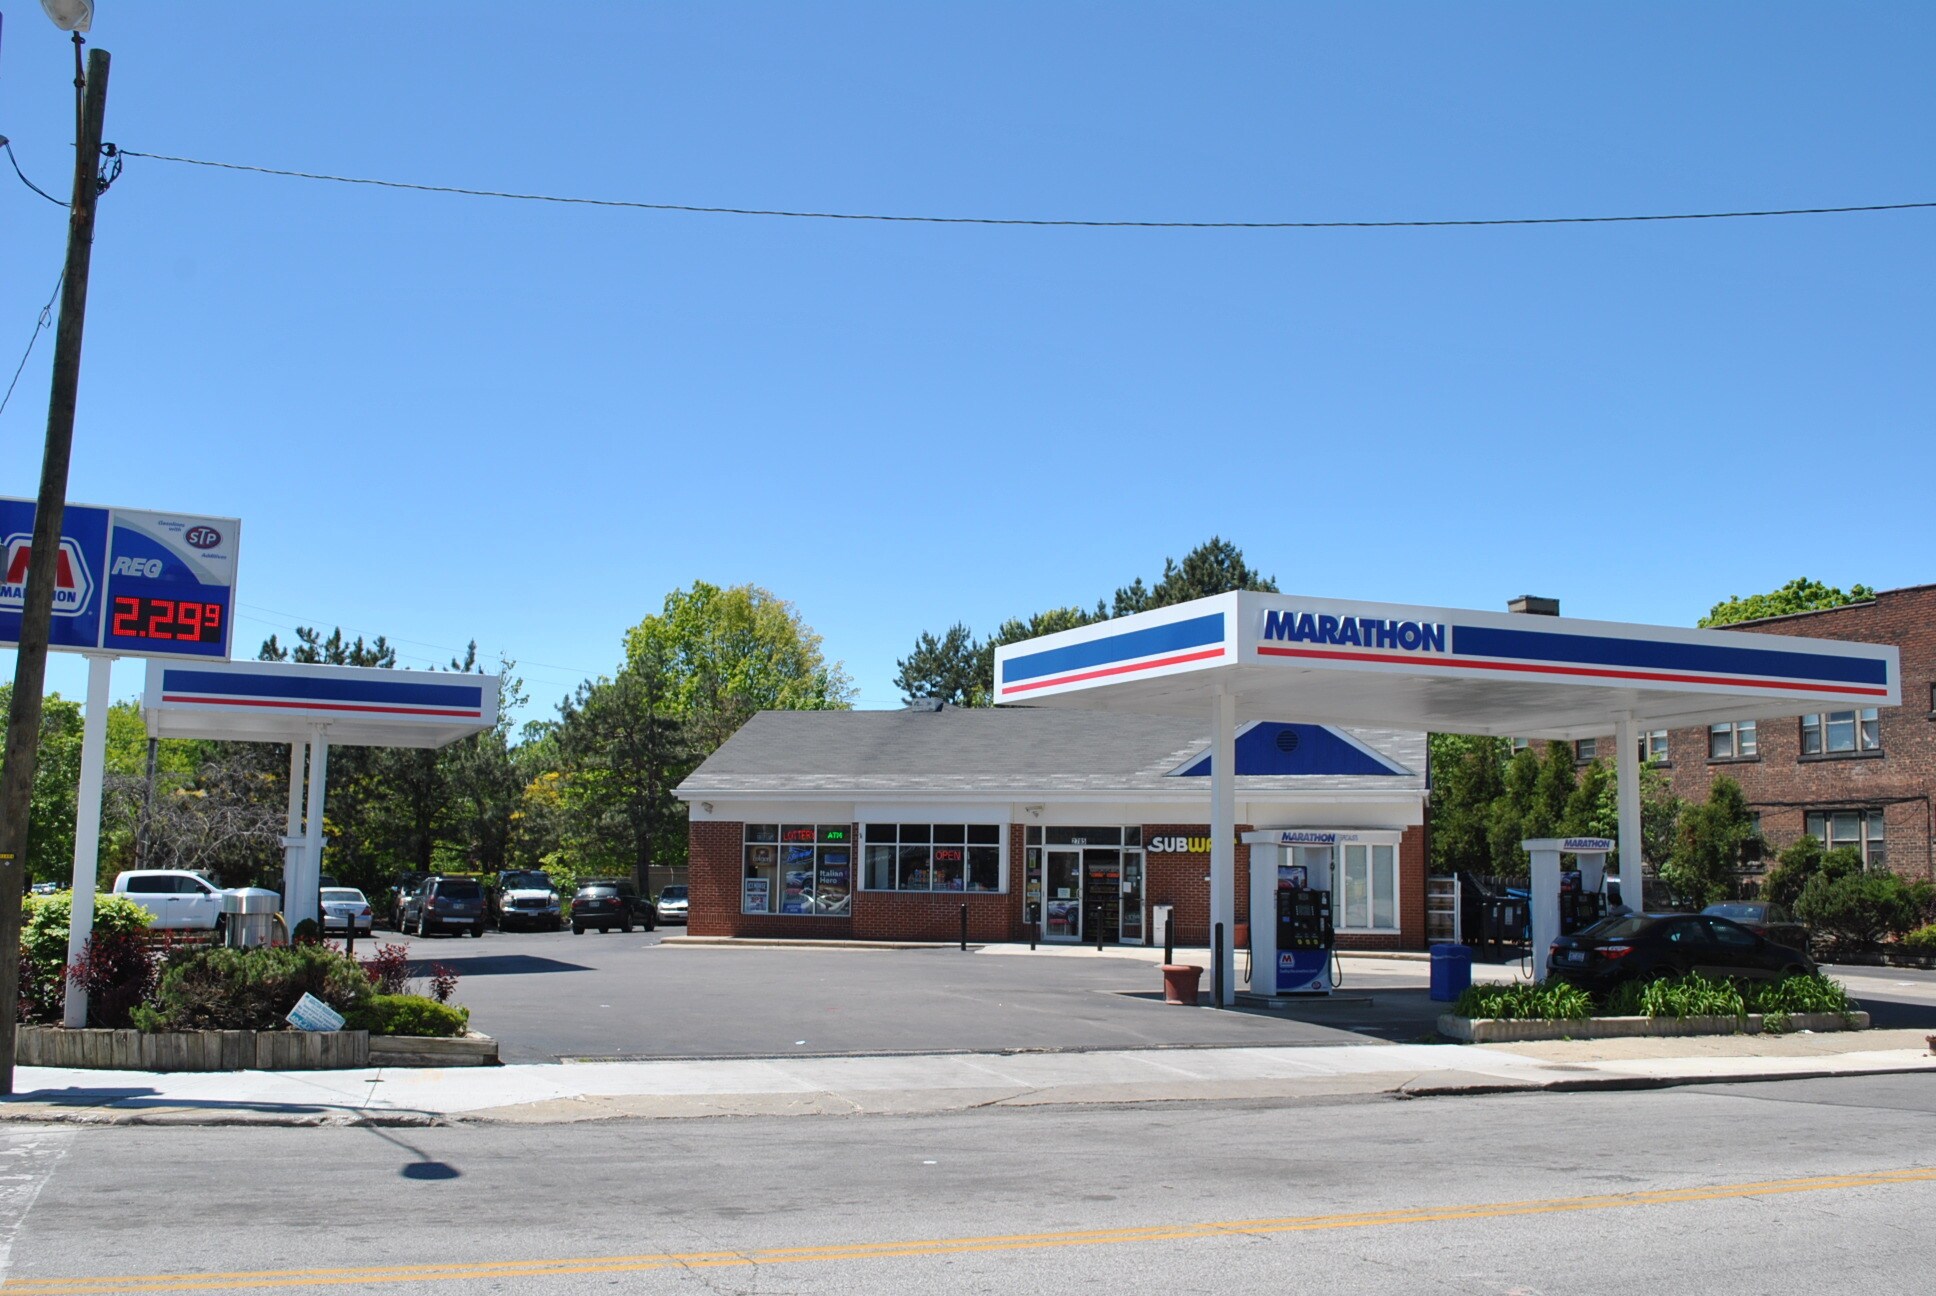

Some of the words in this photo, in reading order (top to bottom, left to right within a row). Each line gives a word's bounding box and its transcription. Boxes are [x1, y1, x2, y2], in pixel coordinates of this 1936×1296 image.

[189, 528, 217, 545] STP
[111, 556, 163, 578] REG
[1263, 609, 1445, 652] MARATHON
[828, 831, 843, 839] ATM
[1282, 832, 1335, 842] MARATHON
[1564, 839, 1610, 848] MARATHON
[936, 850, 960, 860] OPEN
[819, 869, 844, 878] Italian
[819, 876, 838, 885] Hero
